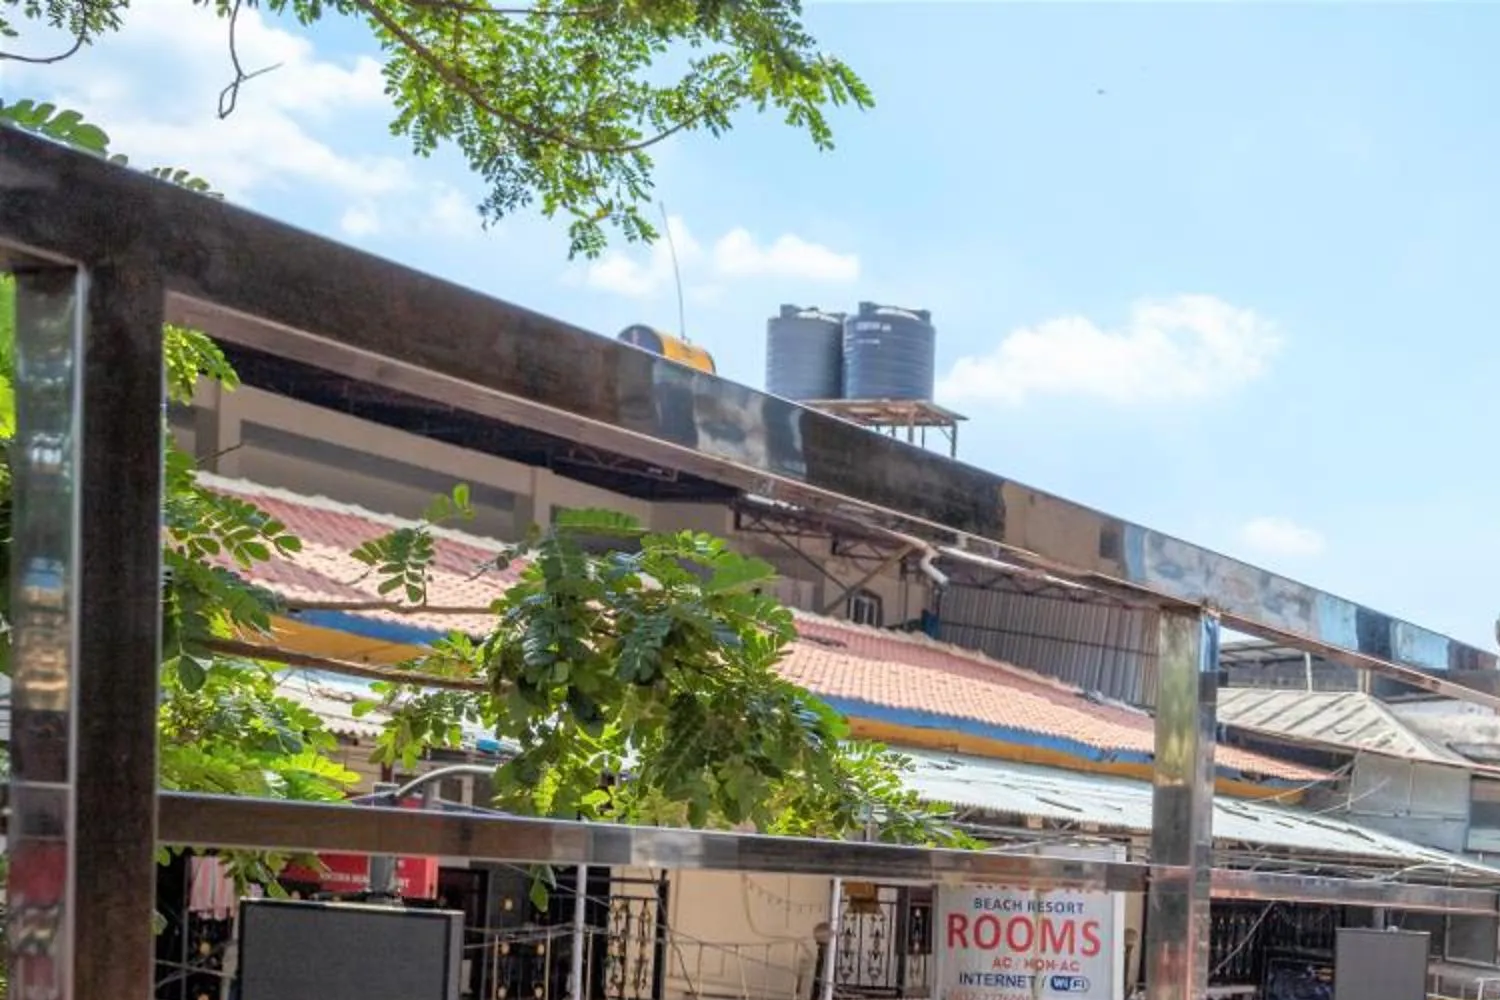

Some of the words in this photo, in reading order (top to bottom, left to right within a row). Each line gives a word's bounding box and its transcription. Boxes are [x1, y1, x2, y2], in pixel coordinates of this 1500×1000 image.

[974, 897, 1022, 912] BEACH
[1027, 899, 1084, 914] RESORT
[946, 912, 1102, 958] ROOMS
[992, 957, 1012, 970] AC
[959, 972, 1036, 989] INTERNET
